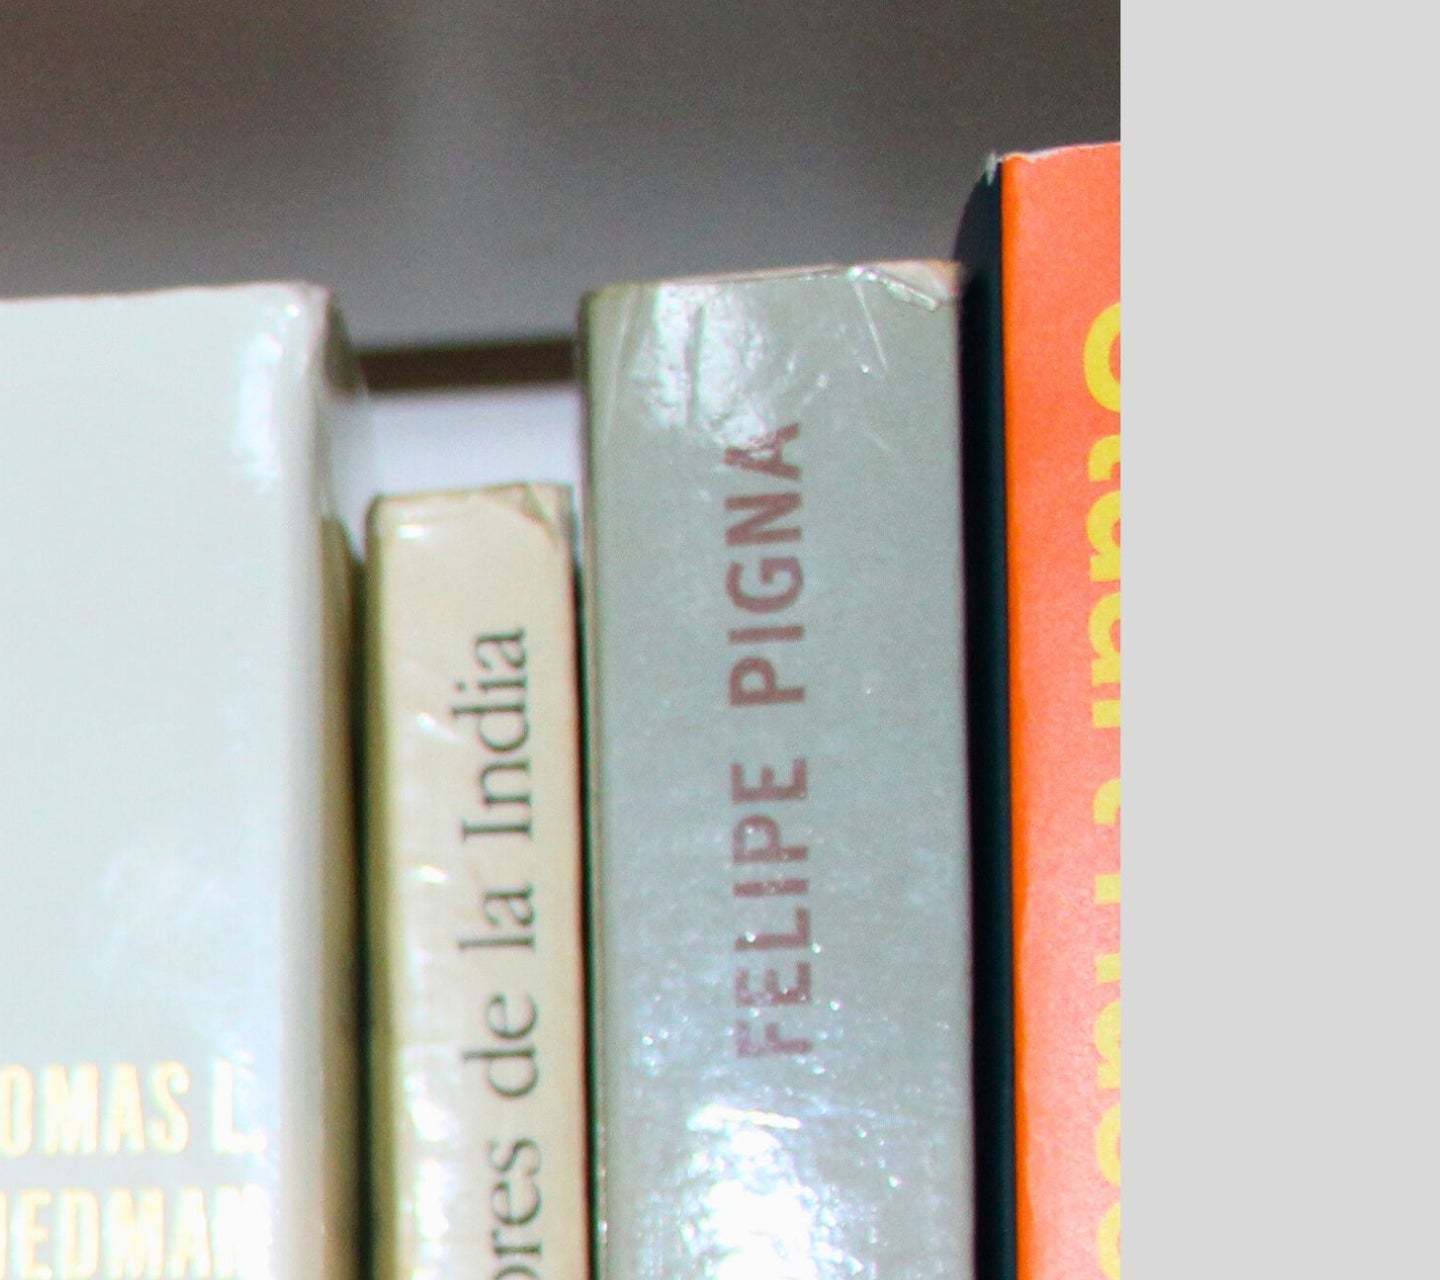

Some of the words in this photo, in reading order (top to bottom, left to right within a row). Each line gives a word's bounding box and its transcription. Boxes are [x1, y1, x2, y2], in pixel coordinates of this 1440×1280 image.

[724, 420, 804, 708] PIGNA
[453, 627, 532, 843] India
[458, 884, 535, 952] la
[731, 756, 814, 1061] FELIPE
[463, 993, 539, 1099] de
